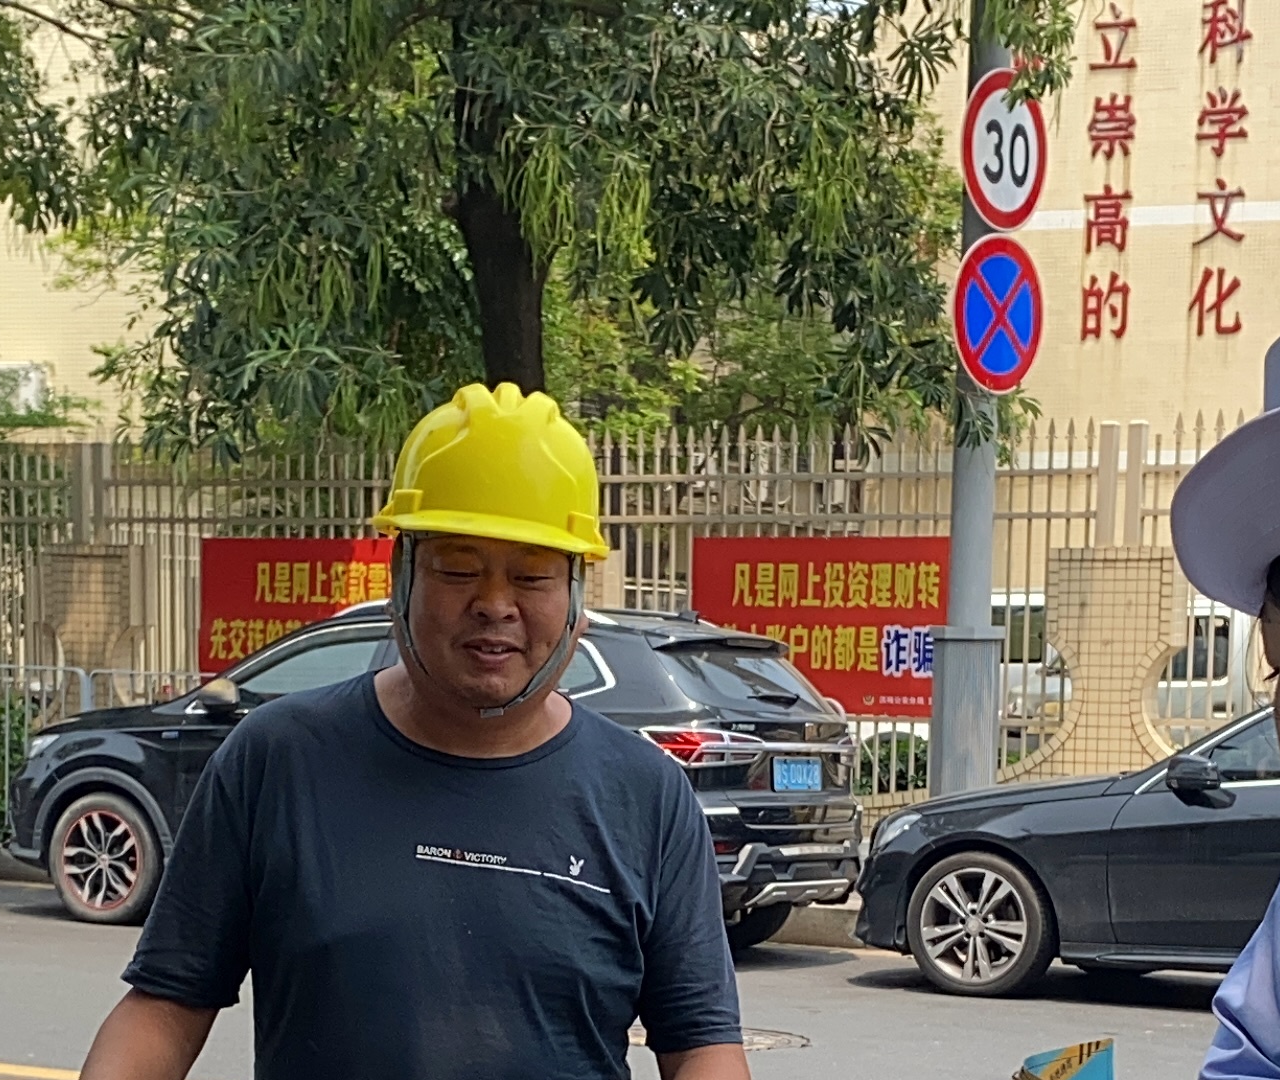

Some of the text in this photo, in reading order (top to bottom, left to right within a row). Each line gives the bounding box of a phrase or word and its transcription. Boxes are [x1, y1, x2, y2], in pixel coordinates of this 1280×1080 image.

[982, 118, 1030, 188] 30
[1080, 2, 1138, 342] 立崇高的
[1188, 0, 1252, 338] 科学文化
[255, 561, 391, 604] 凡是网上贷款需
[732, 562, 941, 609] 凡是网上投资理财转
[416, 845, 452, 858] BARON
